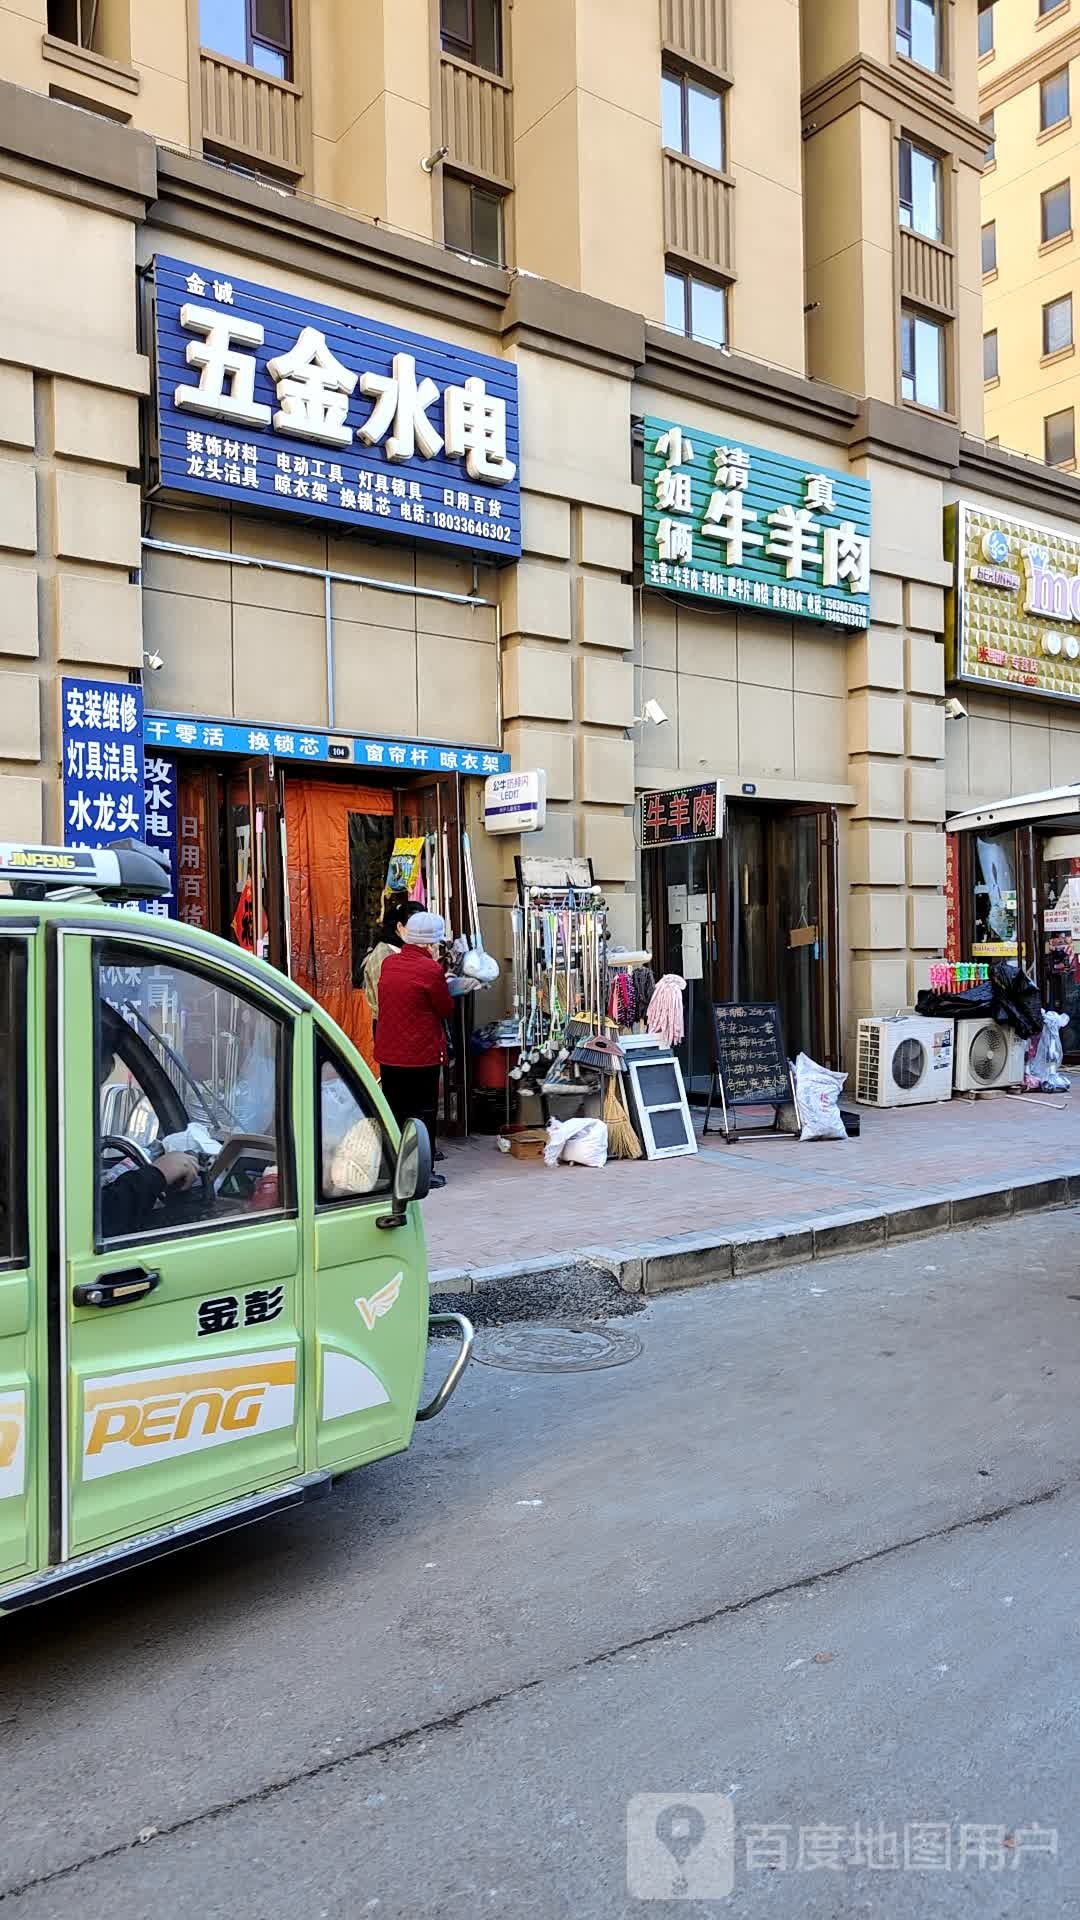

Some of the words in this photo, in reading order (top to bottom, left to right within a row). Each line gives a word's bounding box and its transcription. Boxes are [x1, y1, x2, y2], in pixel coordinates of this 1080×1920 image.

[185, 272, 234, 304] 金诚
[174, 302, 516, 487] 五金水电
[186, 431, 258, 465] 装饰材料
[276, 453, 344, 483] 电动工具
[358, 470, 423, 501] 灯具锁具
[443, 488, 502, 519] 日用百货
[186, 454, 260, 489] 龙头洁具
[274, 474, 329, 501] 晾衣架
[340, 487, 392, 516] 换锁芯
[654, 427, 694, 564] 小姐俩
[702, 490, 871, 594] 牛羊肉
[67, 687, 138, 733] 安装维修
[67, 739, 138, 783] 灯具洁具
[147, 721, 225, 747] 干零活
[248, 731, 320, 756] 换锁芯
[333, 747, 345, 756] 104
[365, 744, 429, 766] 窗帘杆
[440, 752, 500, 772] 晾衣架
[69, 790, 140, 834] 水龙头
[646, 789, 714, 839] 牛羊肉
[9, 851, 76, 869] JINPENG
[198, 1285, 285, 1336] 金彭
[85, 1387, 266, 1455] PENG
